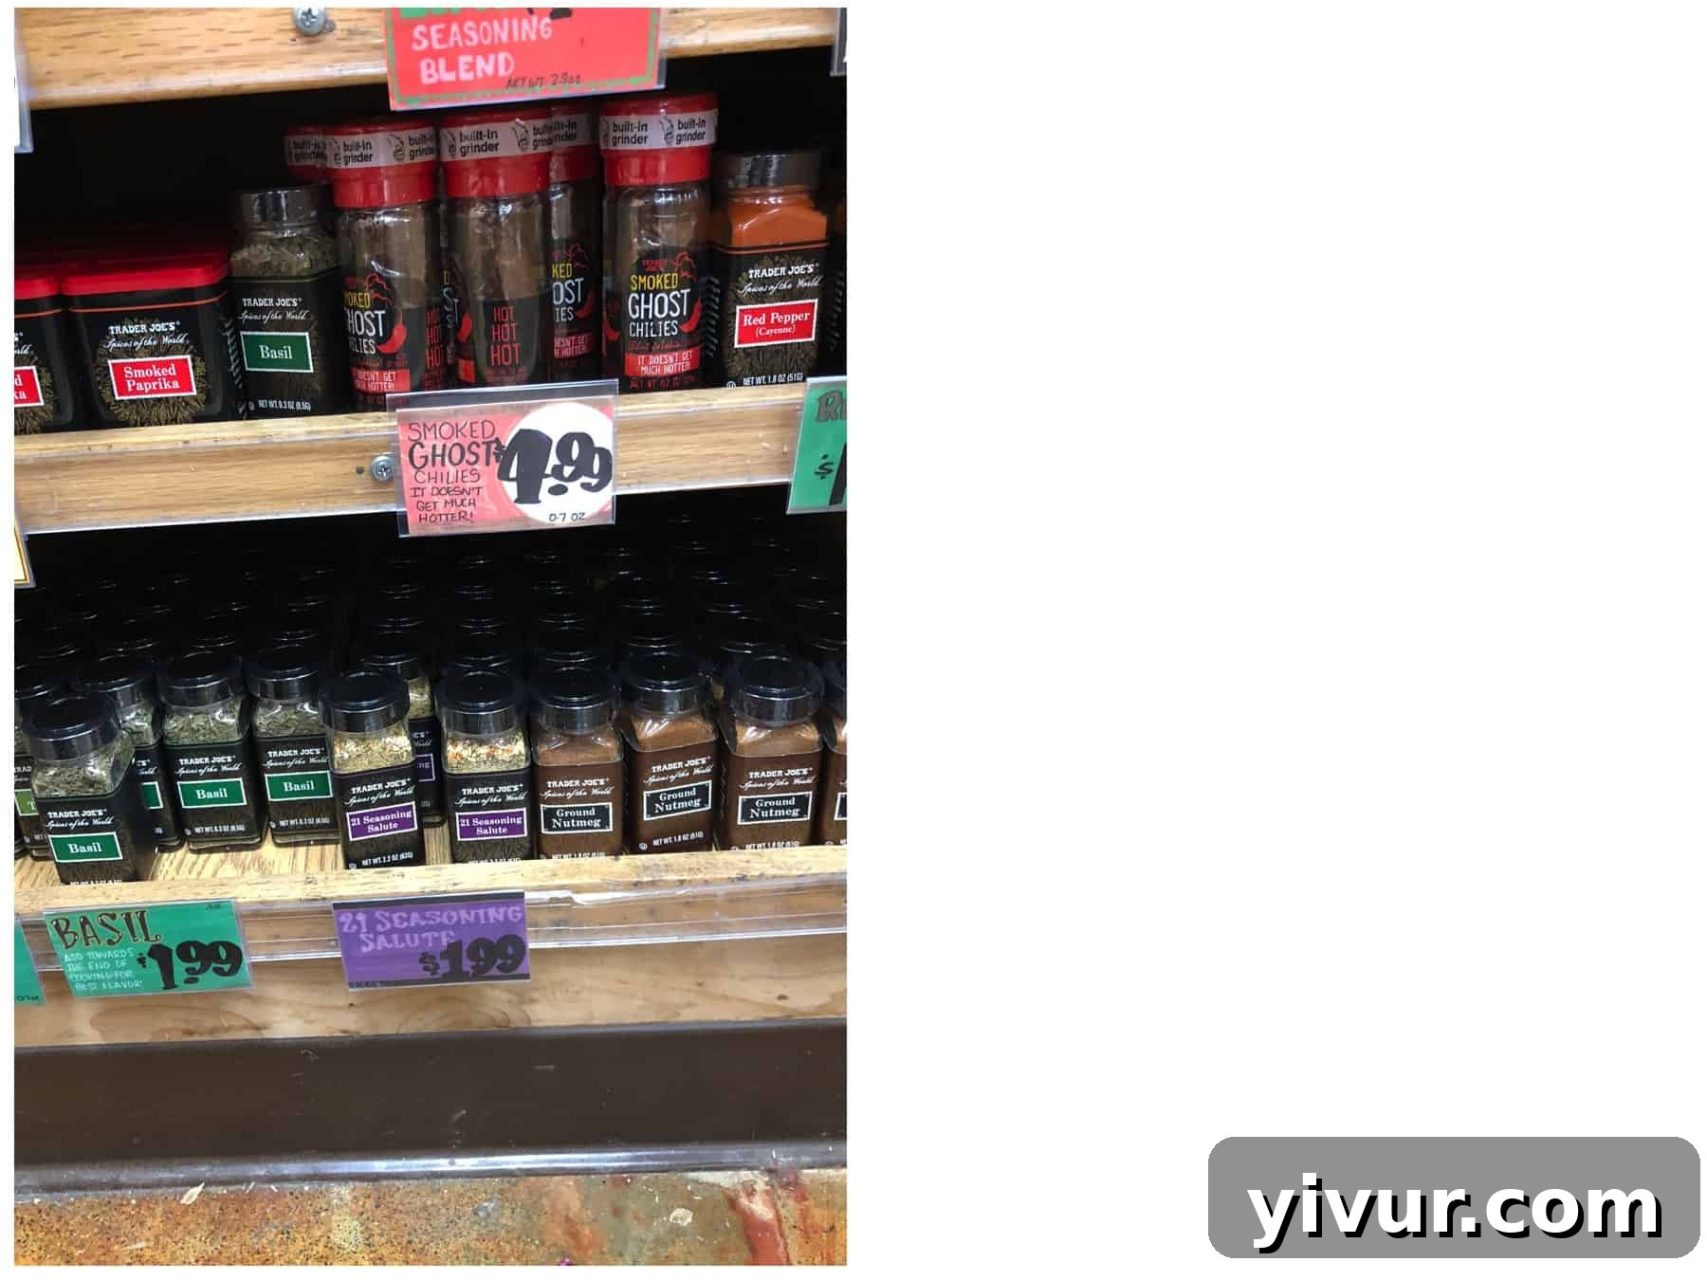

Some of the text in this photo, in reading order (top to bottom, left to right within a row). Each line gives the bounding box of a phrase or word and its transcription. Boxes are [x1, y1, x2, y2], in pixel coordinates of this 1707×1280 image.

[412, 17, 553, 51] SEASONING
[419, 51, 515, 86] BLEND
[612, 133, 649, 146] grinder
[459, 141, 500, 156] grinder
[748, 263, 814, 279] TRADER JOE'S
[630, 273, 678, 291] SMOKED
[628, 288, 691, 320] GHOST
[493, 307, 514, 321] HOT
[743, 311, 810, 327] Red Pepper
[108, 321, 176, 335] TRADER JOE'S
[491, 323, 517, 342] HOT
[629, 320, 678, 338] CHILIES
[755, 325, 796, 337] (Cayenne)
[259, 344, 292, 360] Basil
[490, 344, 521, 366] HOT
[124, 365, 177, 379] Smoked
[126, 378, 179, 392] Paprika
[408, 420, 496, 442] SMOKED
[408, 440, 498, 470] GHOST
[414, 468, 480, 484] CHILIES
[410, 486, 483, 497] IT DOESN'T
[416, 498, 476, 512] GET MUCH
[419, 512, 474, 524] HOTTER!
[282, 780, 315, 792] Basil
[755, 796, 796, 807] Ground
[350, 810, 413, 827] 21 Seasoning
[556, 807, 596, 819] Ground
[750, 807, 801, 820] Nutmeg
[367, 821, 398, 833] Salute
[460, 816, 522, 829] 21 Seasoning
[551, 817, 602, 830] Nutmeg
[476, 826, 508, 836] Salute
[68, 842, 102, 854] Basil
[340, 906, 523, 933] 21 SEASONING
[51, 910, 162, 949] BASIL
[358, 930, 455, 953] SALUTE
[88, 961, 110, 970] END
[137, 940, 243, 990] $1.99
